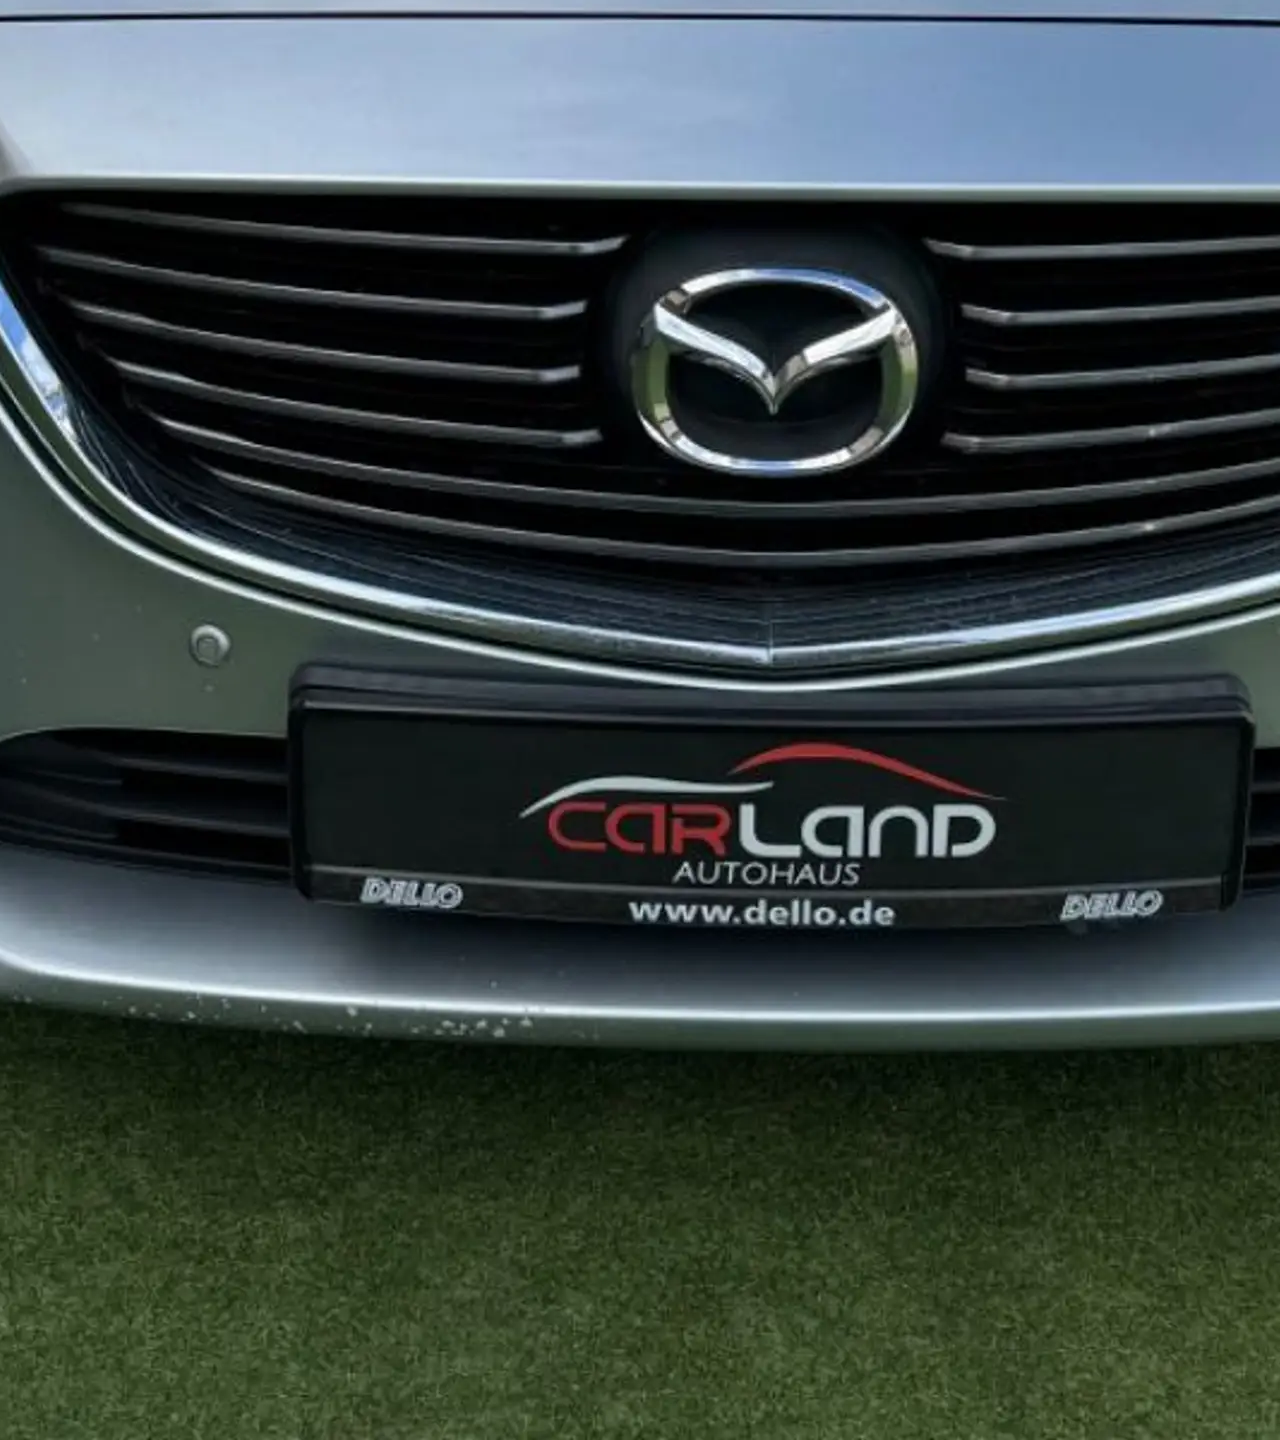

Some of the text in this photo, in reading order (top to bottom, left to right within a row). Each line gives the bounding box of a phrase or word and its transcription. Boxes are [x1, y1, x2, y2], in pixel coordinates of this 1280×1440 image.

[672, 860, 861, 887] AUTOHAUS
[359, 876, 464, 910] DELLO
[1059, 889, 1164, 922] DELLO
[628, 898, 896, 928] www.dello.de
